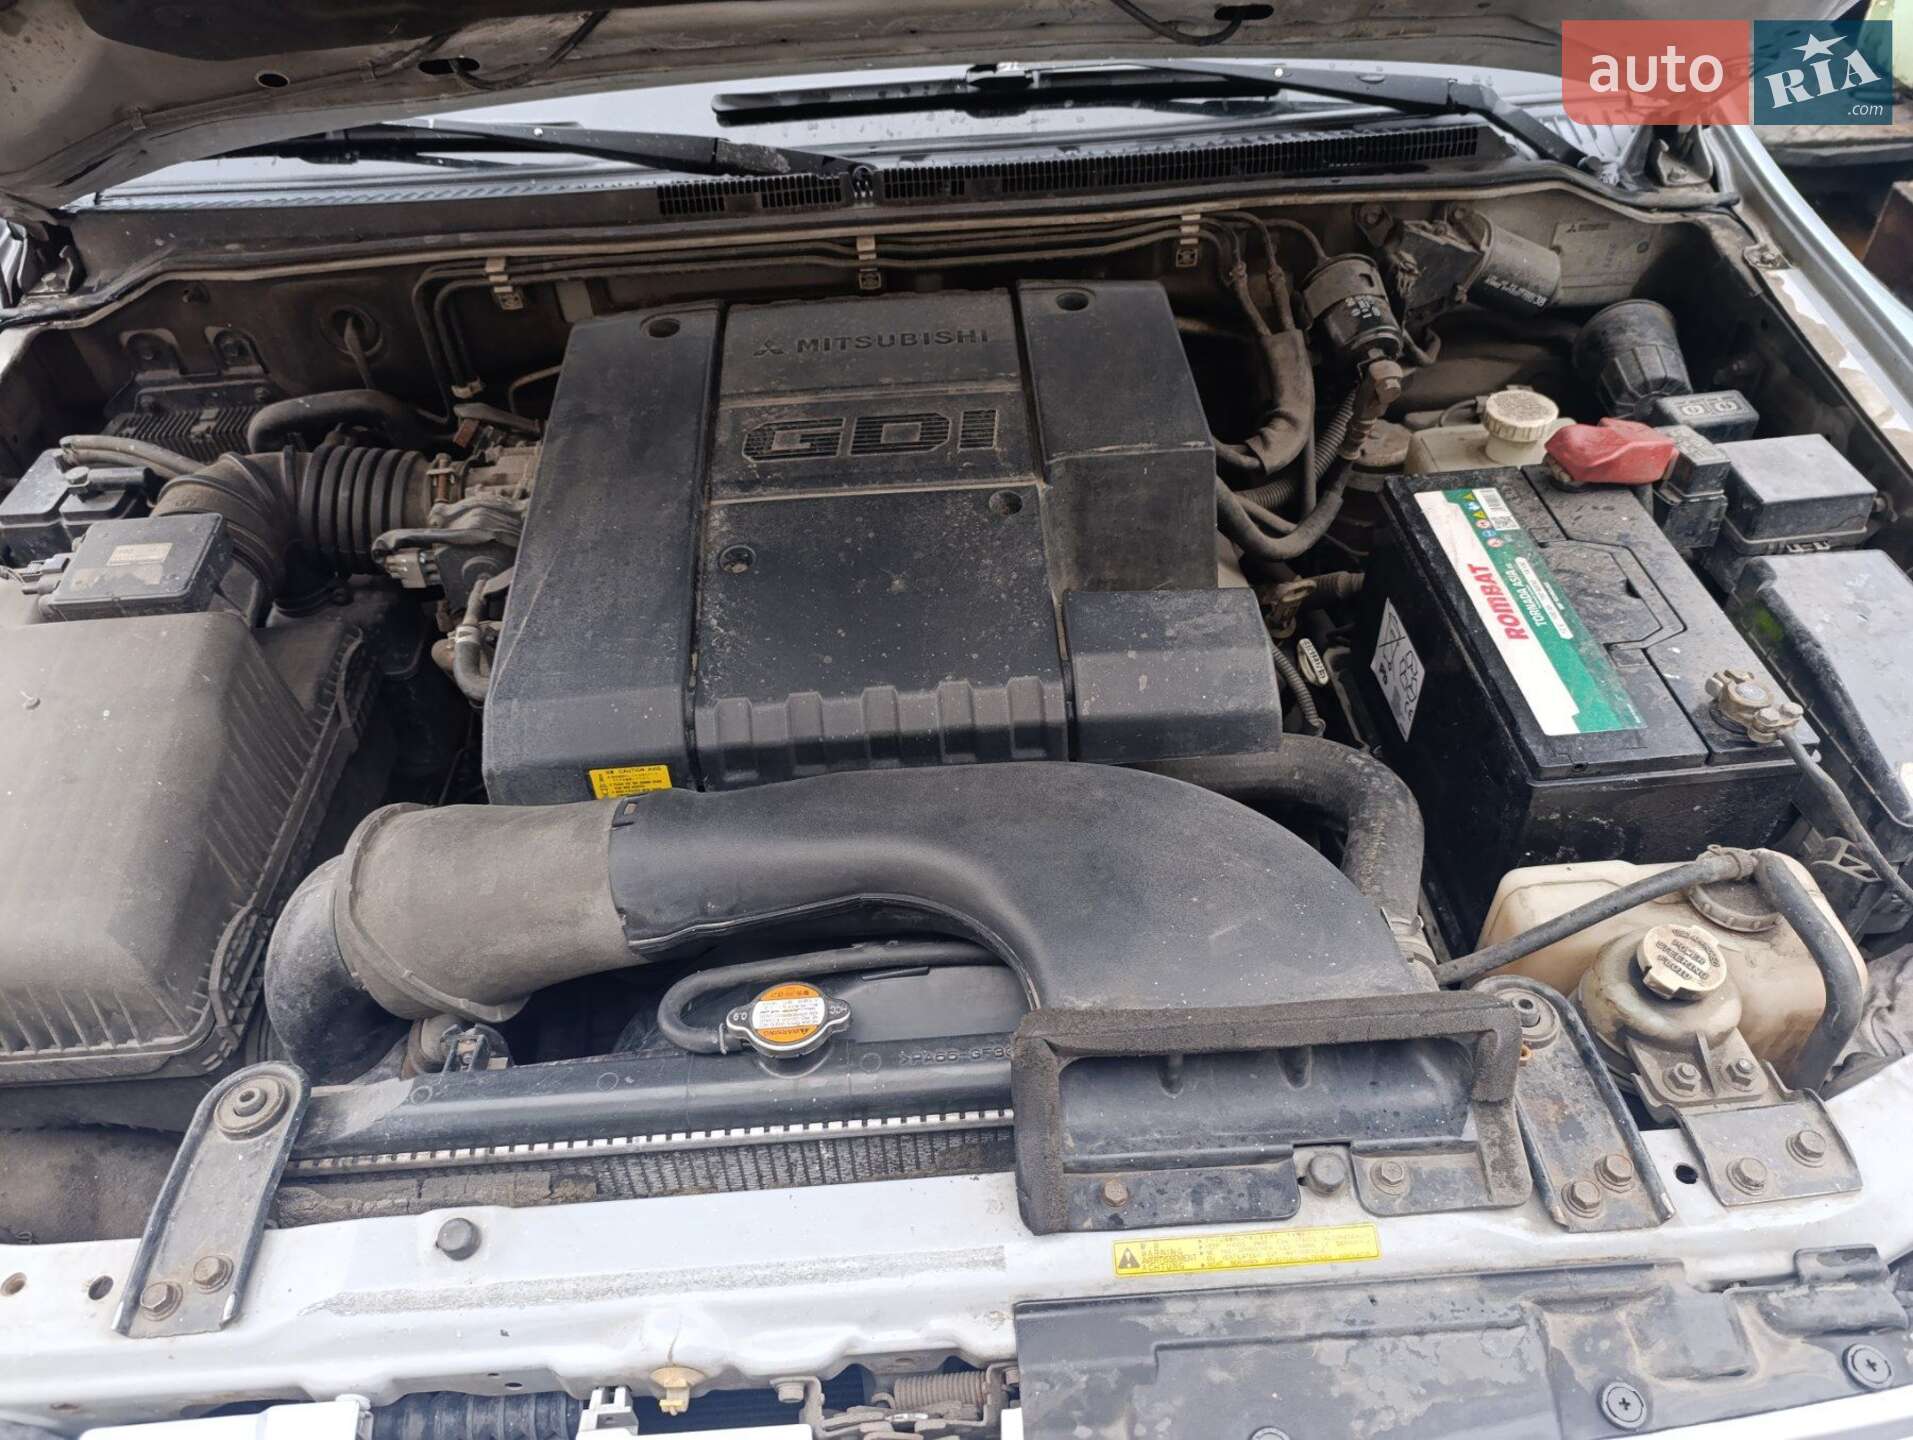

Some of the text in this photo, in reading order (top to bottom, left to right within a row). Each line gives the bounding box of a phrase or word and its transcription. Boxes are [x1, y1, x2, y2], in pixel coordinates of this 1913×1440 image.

[797, 328, 989, 353] MITSUBISHI
[742, 408, 1000, 463] GDI
[1467, 563, 1529, 640] ROMBAT
